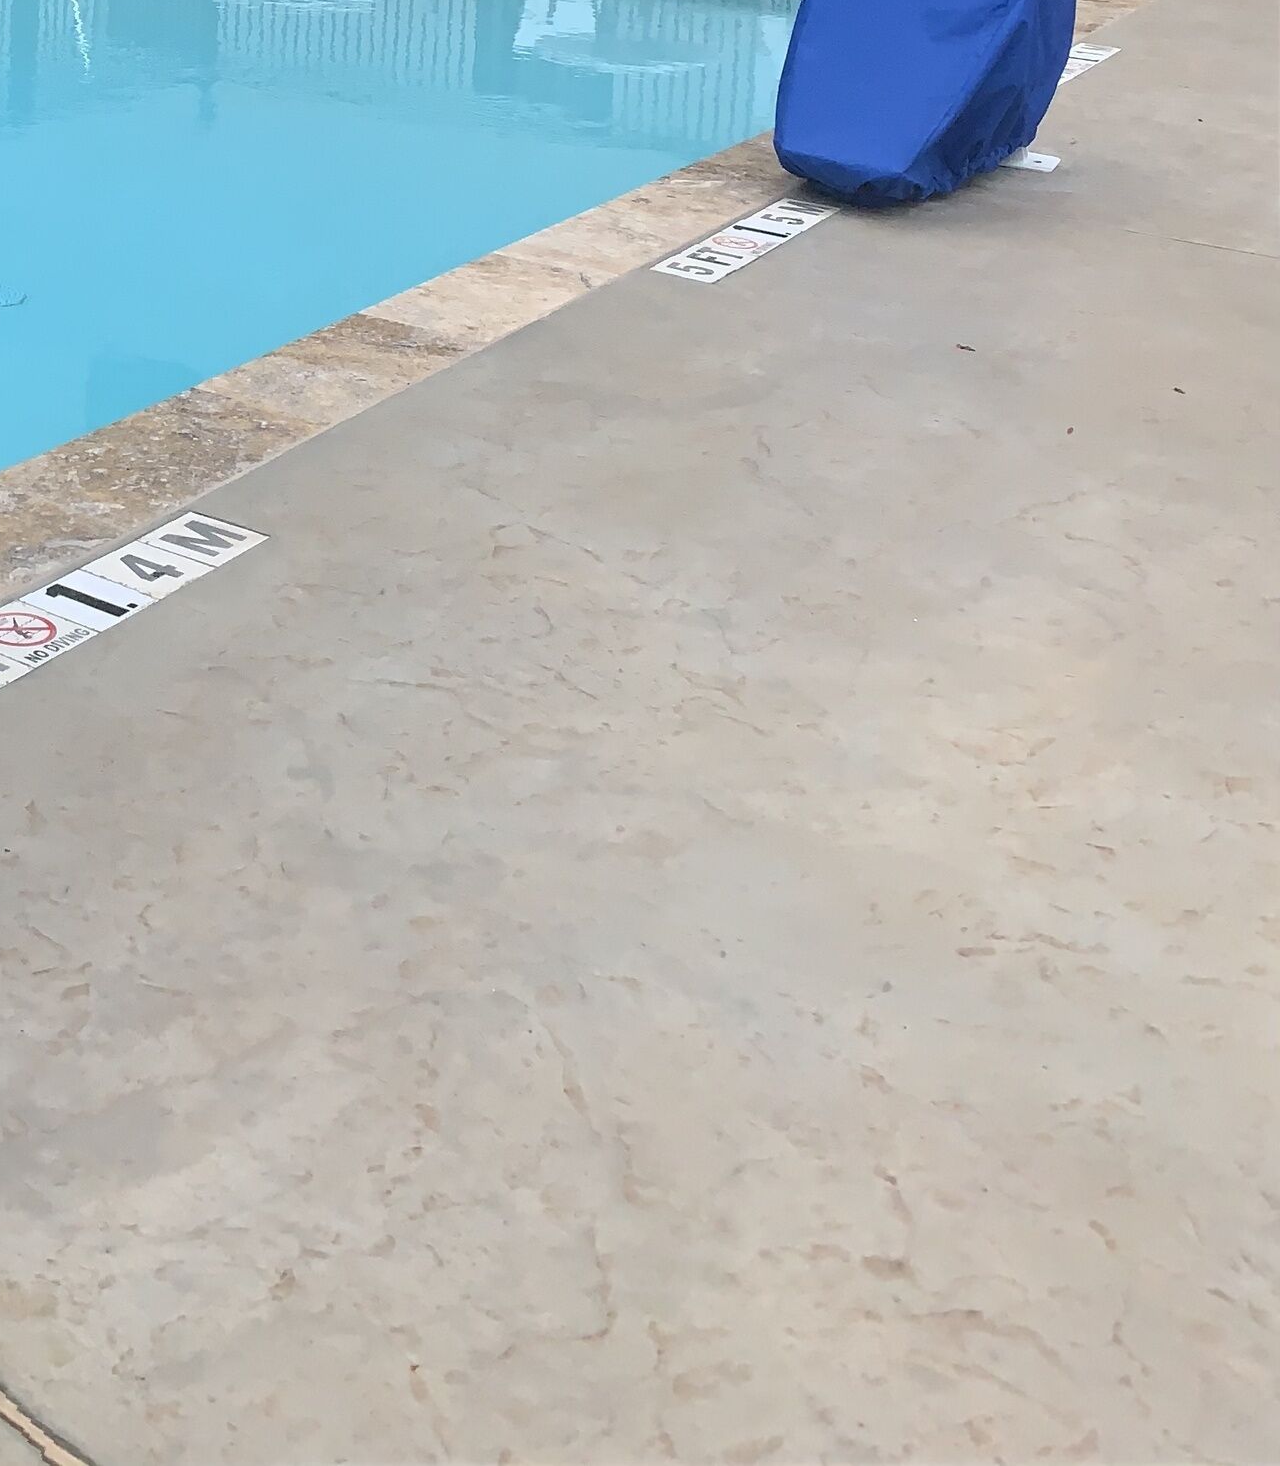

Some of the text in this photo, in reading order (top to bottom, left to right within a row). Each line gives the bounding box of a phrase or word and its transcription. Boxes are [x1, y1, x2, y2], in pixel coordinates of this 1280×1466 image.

[778, 200, 834, 216] M
[686, 246, 744, 266] FT
[666, 261, 715, 276] 5
[165, 520, 247, 555] M
[23, 627, 90, 664] NO DIVING
